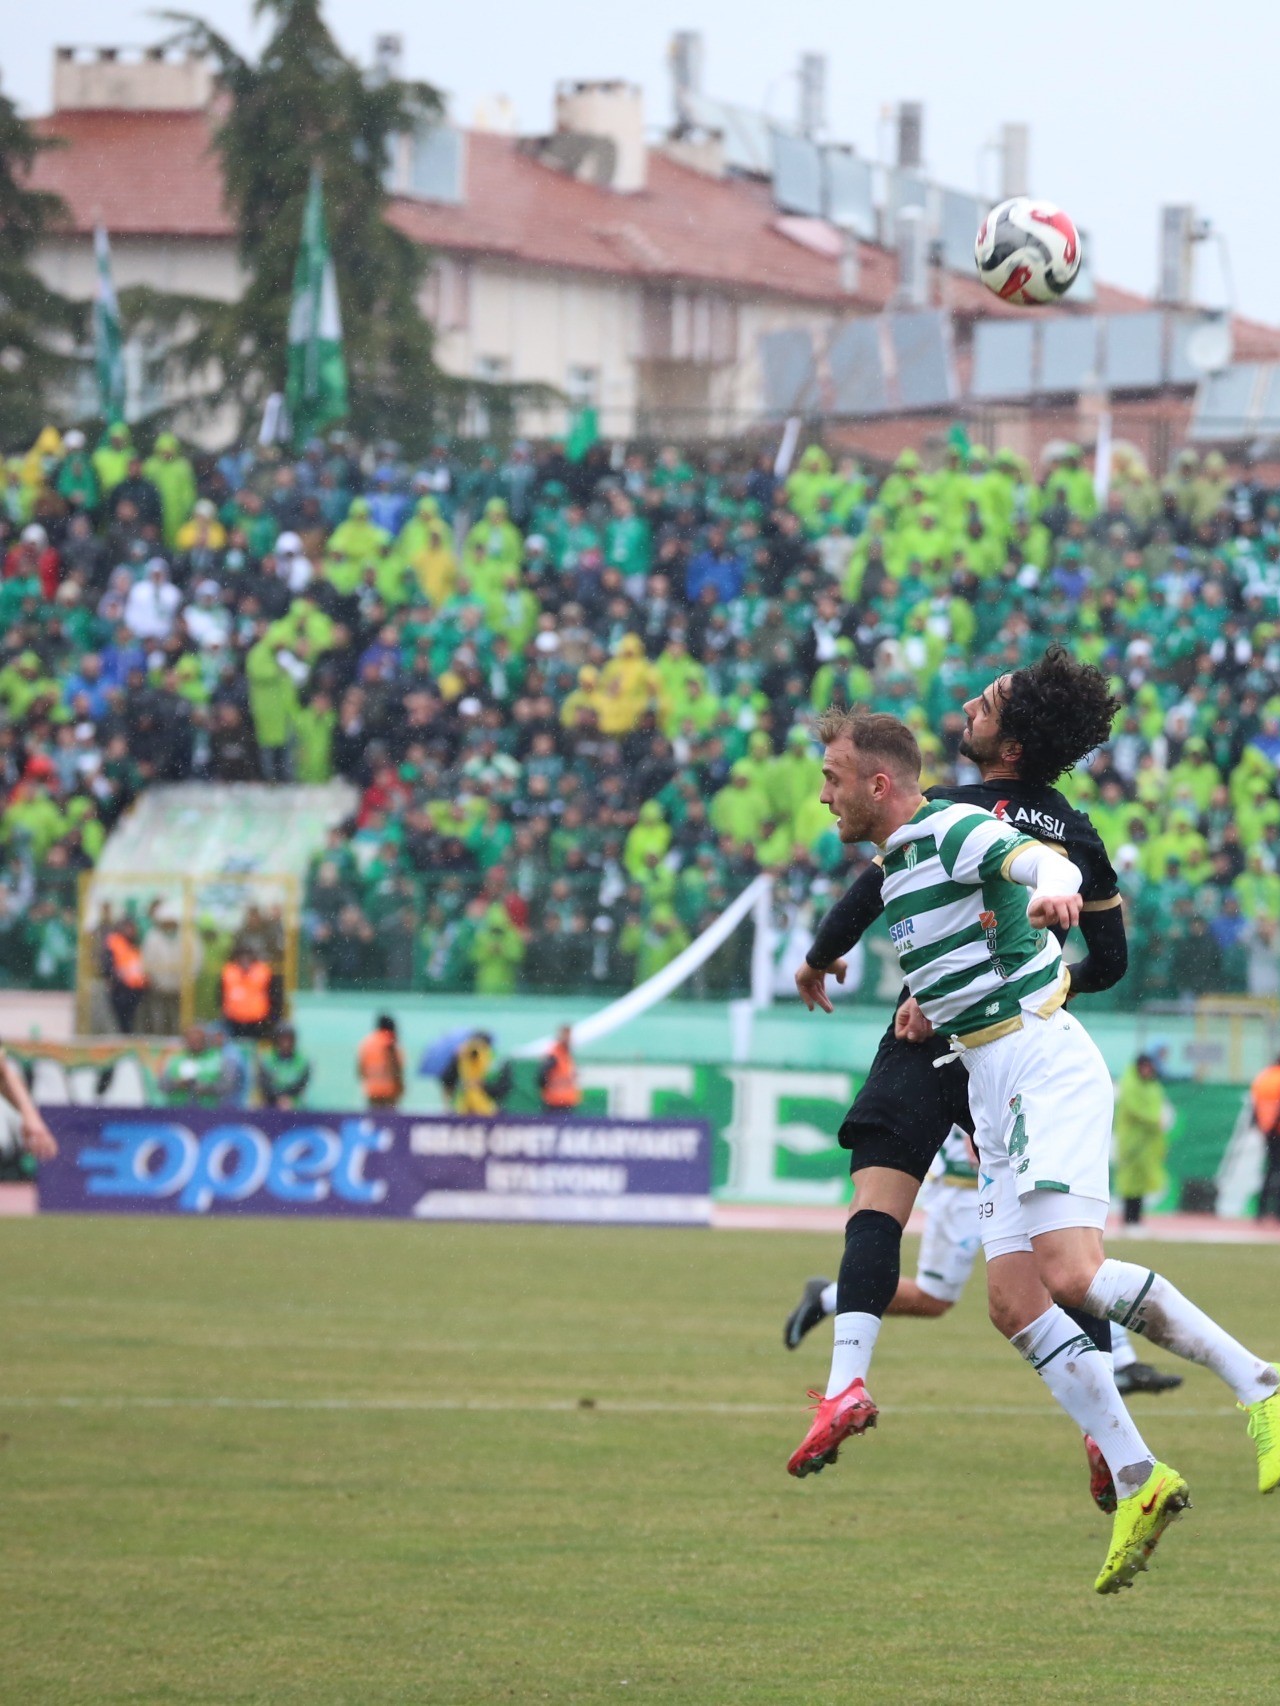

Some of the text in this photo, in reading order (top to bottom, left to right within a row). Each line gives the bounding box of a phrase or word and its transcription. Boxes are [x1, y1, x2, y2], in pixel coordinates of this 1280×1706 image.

[1014, 806, 1066, 838] AKSU
[1007, 1112, 1029, 1157] 4
[79, 1118, 395, 1212] opet
